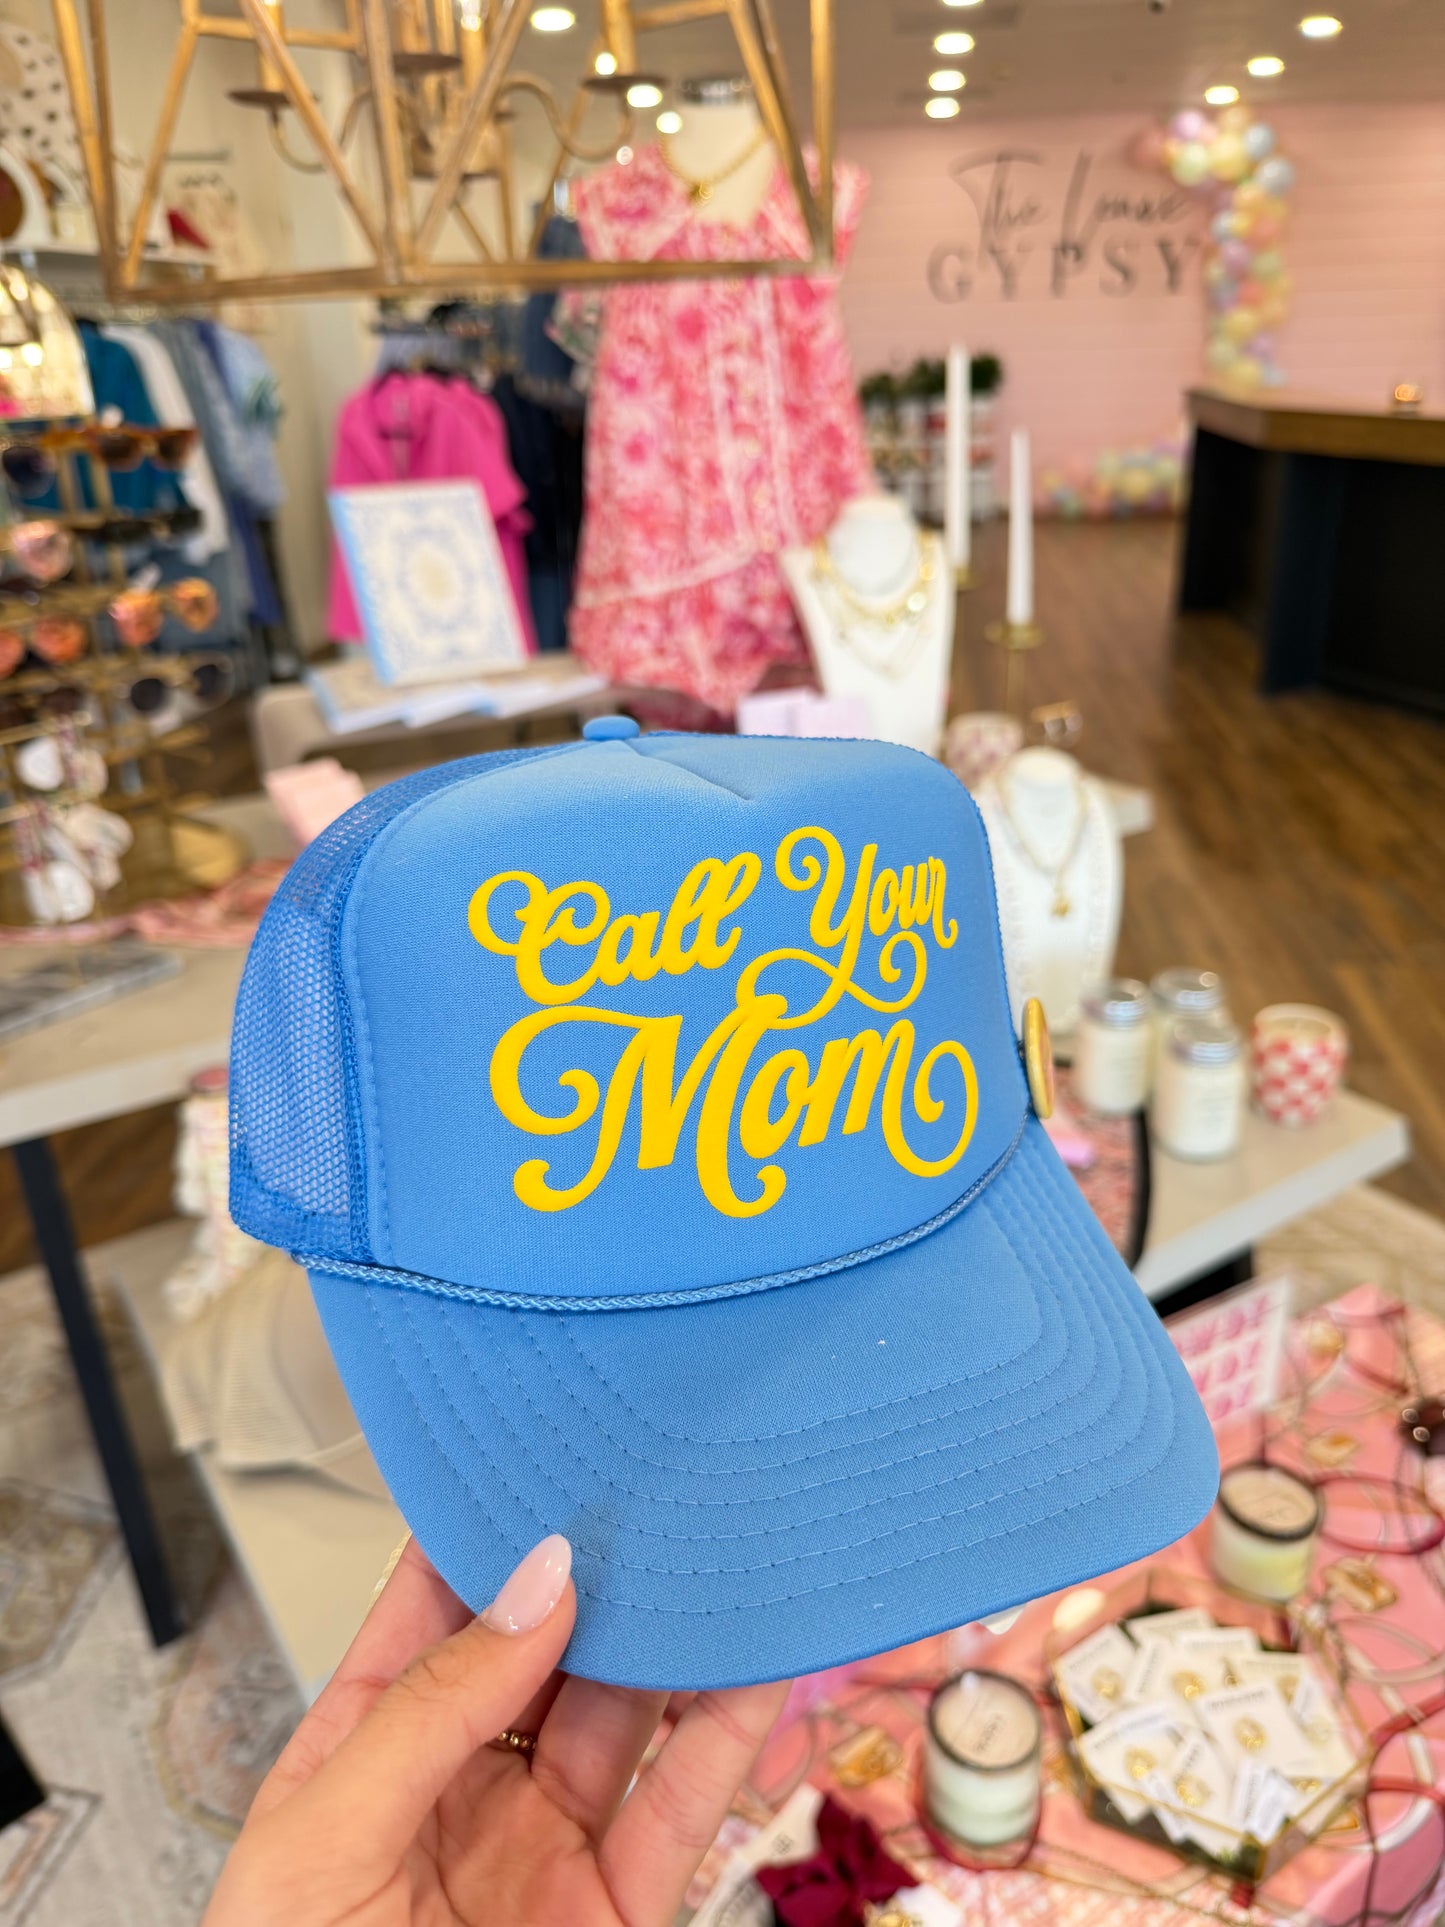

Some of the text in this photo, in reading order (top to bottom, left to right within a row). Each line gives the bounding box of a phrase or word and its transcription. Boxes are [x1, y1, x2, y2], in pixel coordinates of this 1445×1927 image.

[926, 239, 1201, 303] GYPSY
[948, 150, 1046, 270] The
[467, 826, 959, 1030] Call Your
[489, 994, 979, 1219] Mom
